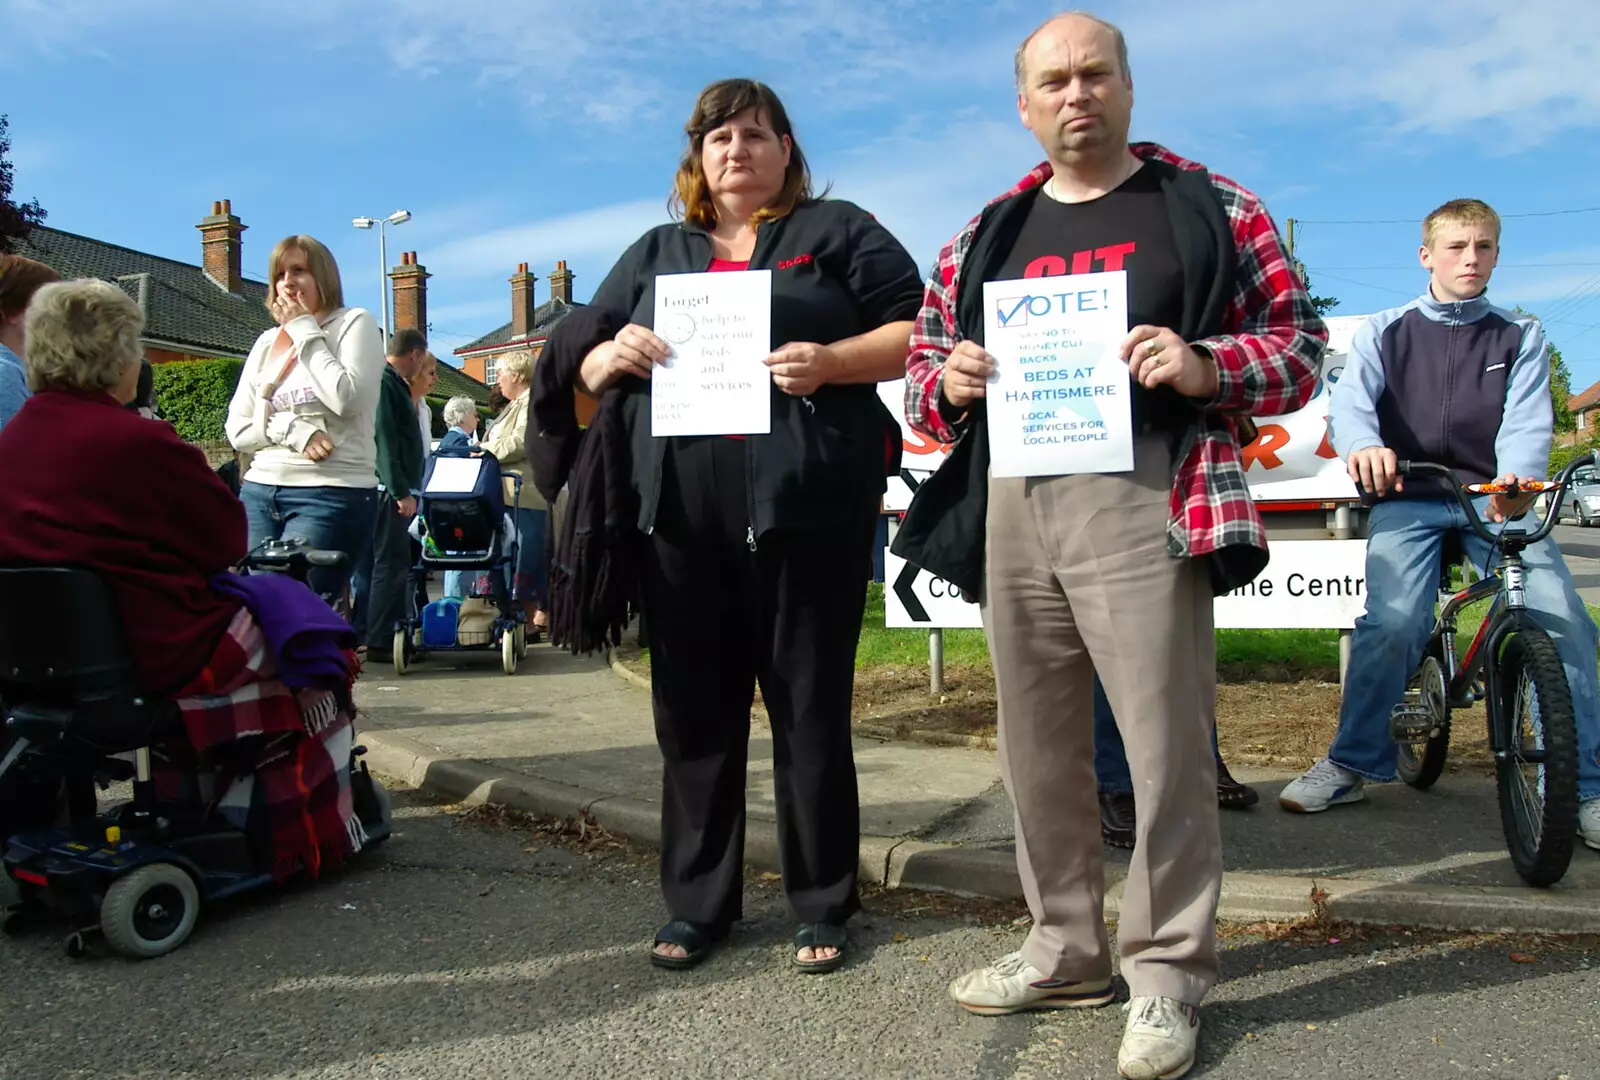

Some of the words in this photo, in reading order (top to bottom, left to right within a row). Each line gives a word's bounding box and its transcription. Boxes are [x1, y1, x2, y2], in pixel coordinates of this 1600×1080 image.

[1019, 353, 1058, 364] BACKS
[700, 362, 724, 374] and
[1023, 369, 1069, 383] BEDS
[1073, 366, 1095, 379] AT
[700, 380, 752, 391] services
[1005, 384, 1117, 402] HARTISMERE
[1021, 410, 1059, 421] LOCAL
[1022, 421, 1078, 433] SERVICES
[1080, 419, 1104, 429] FOR
[1023, 435, 1061, 446] LOCAL
[1063, 432, 1109, 444] PEOPLE
[929, 576, 961, 598] Co
[1287, 573, 1365, 597] Centr
